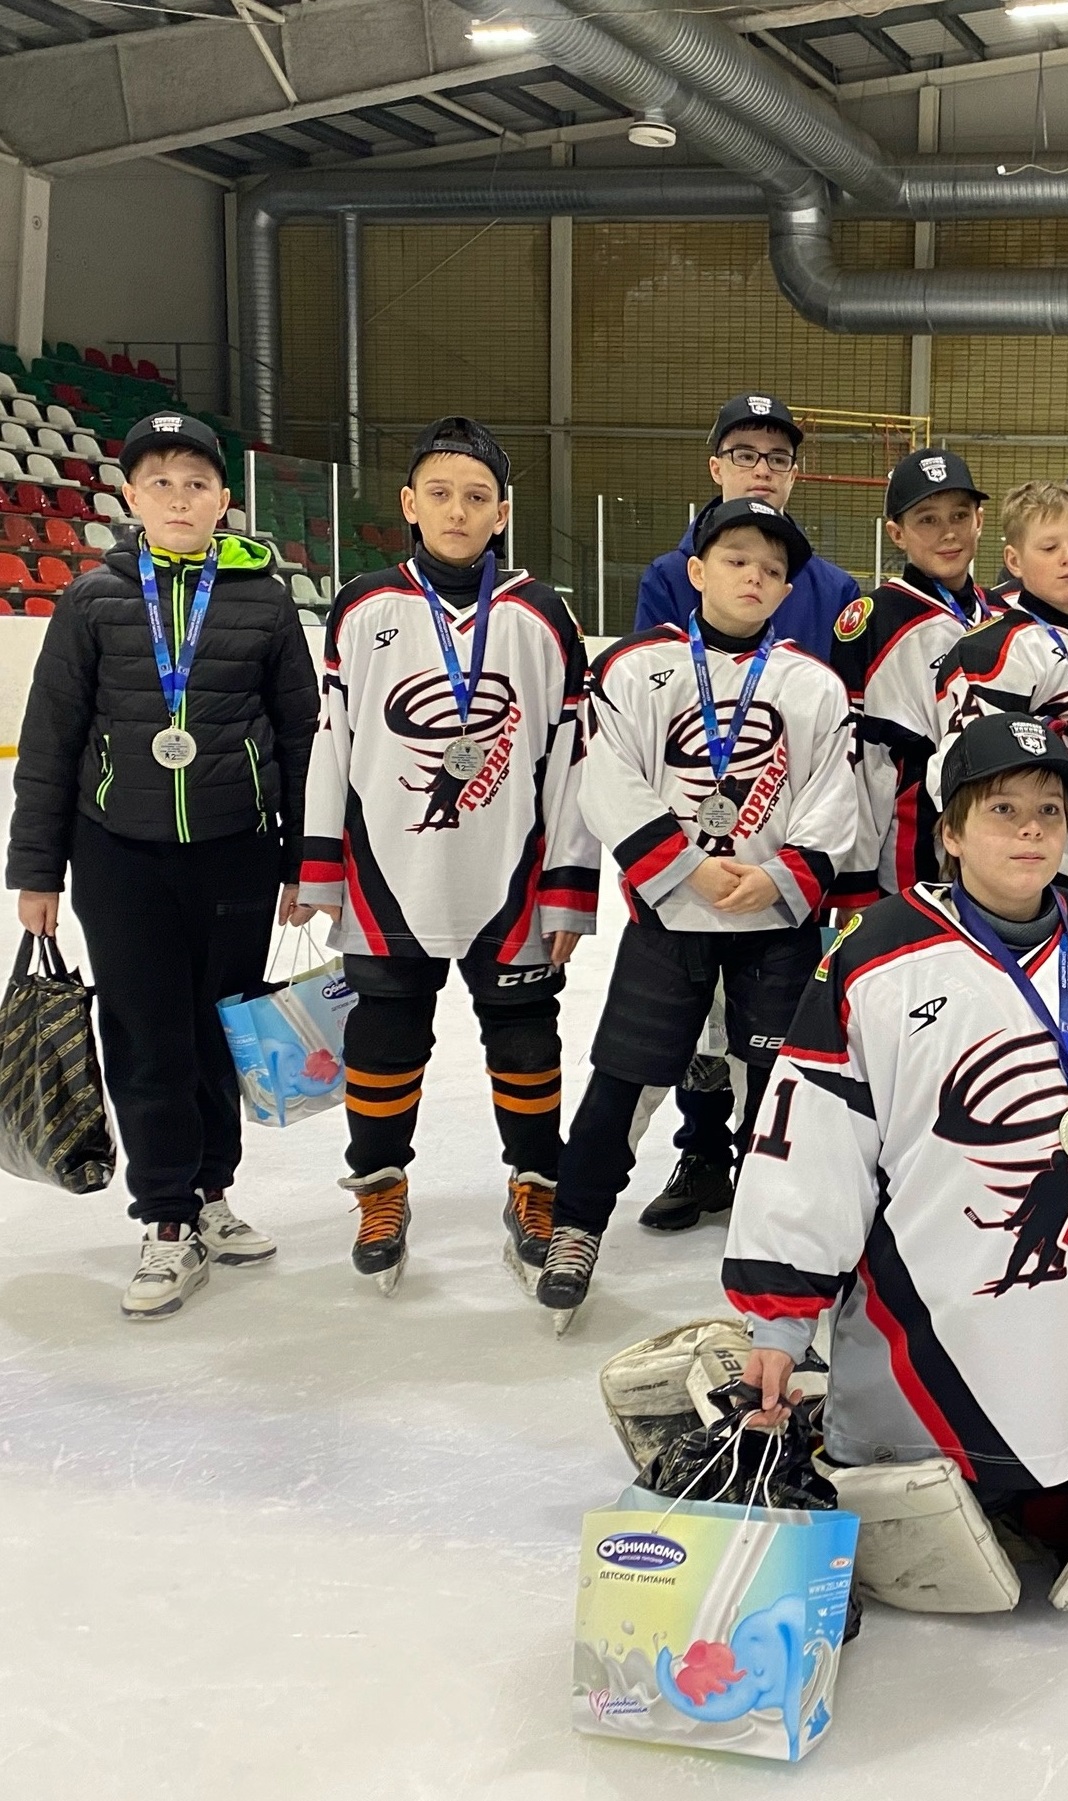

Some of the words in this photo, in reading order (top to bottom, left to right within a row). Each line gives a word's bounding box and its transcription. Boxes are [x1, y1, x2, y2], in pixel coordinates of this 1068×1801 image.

[598, 1540, 685, 1563] Обнимама
[600, 1570, 635, 1583] ДЕТСКОЕ
[637, 1574, 677, 1586] ПИТАНИЕ
